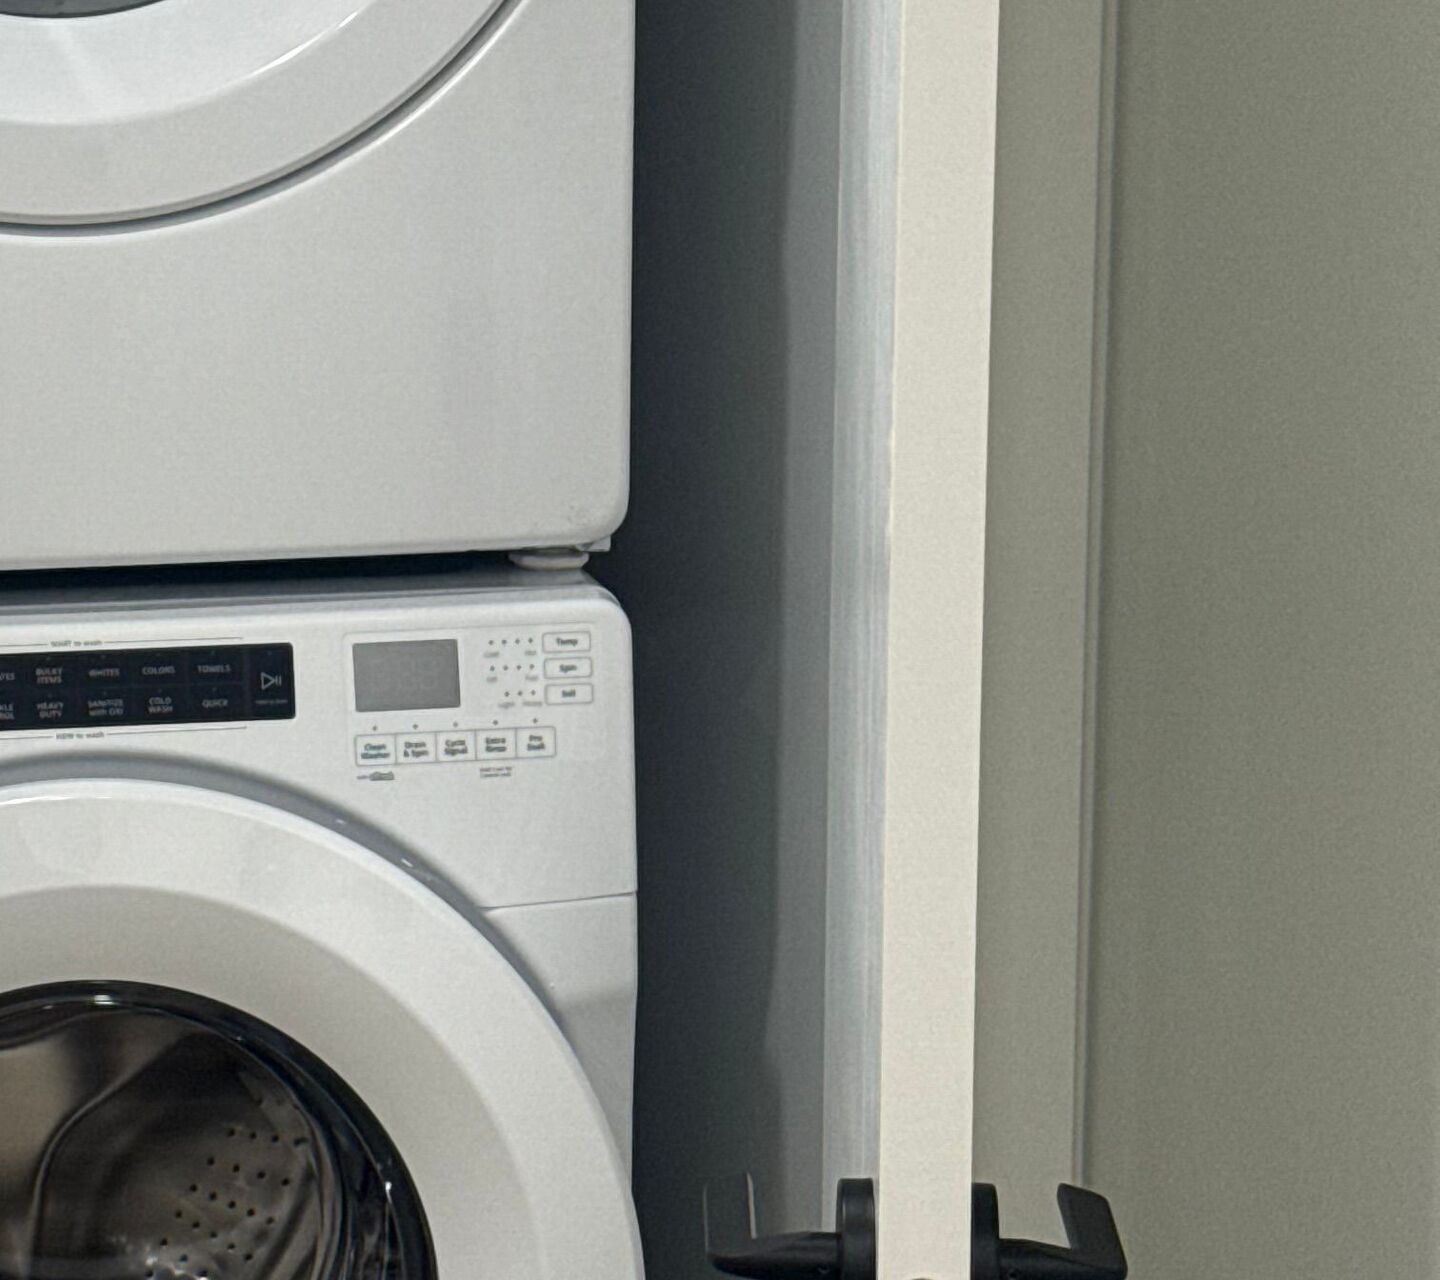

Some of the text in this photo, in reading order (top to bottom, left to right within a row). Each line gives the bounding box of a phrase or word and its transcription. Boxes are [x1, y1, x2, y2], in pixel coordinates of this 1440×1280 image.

[556, 637, 578, 646] Temp
[35, 668, 62, 676] BULKY
[88, 668, 120, 677] WHITES
[142, 666, 176, 675] COLORS
[197, 664, 232, 674] TOWELS
[559, 664, 577, 673] Spin
[37, 676, 62, 684] ITEMS
[37, 702, 64, 710] HEAVY
[149, 697, 172, 706] COLD
[201, 699, 229, 708] QUICK
[39, 710, 62, 719] DUTY
[148, 706, 173, 714] WASH
[364, 743, 386, 751] Clean
[445, 739, 466, 747] Cycle
